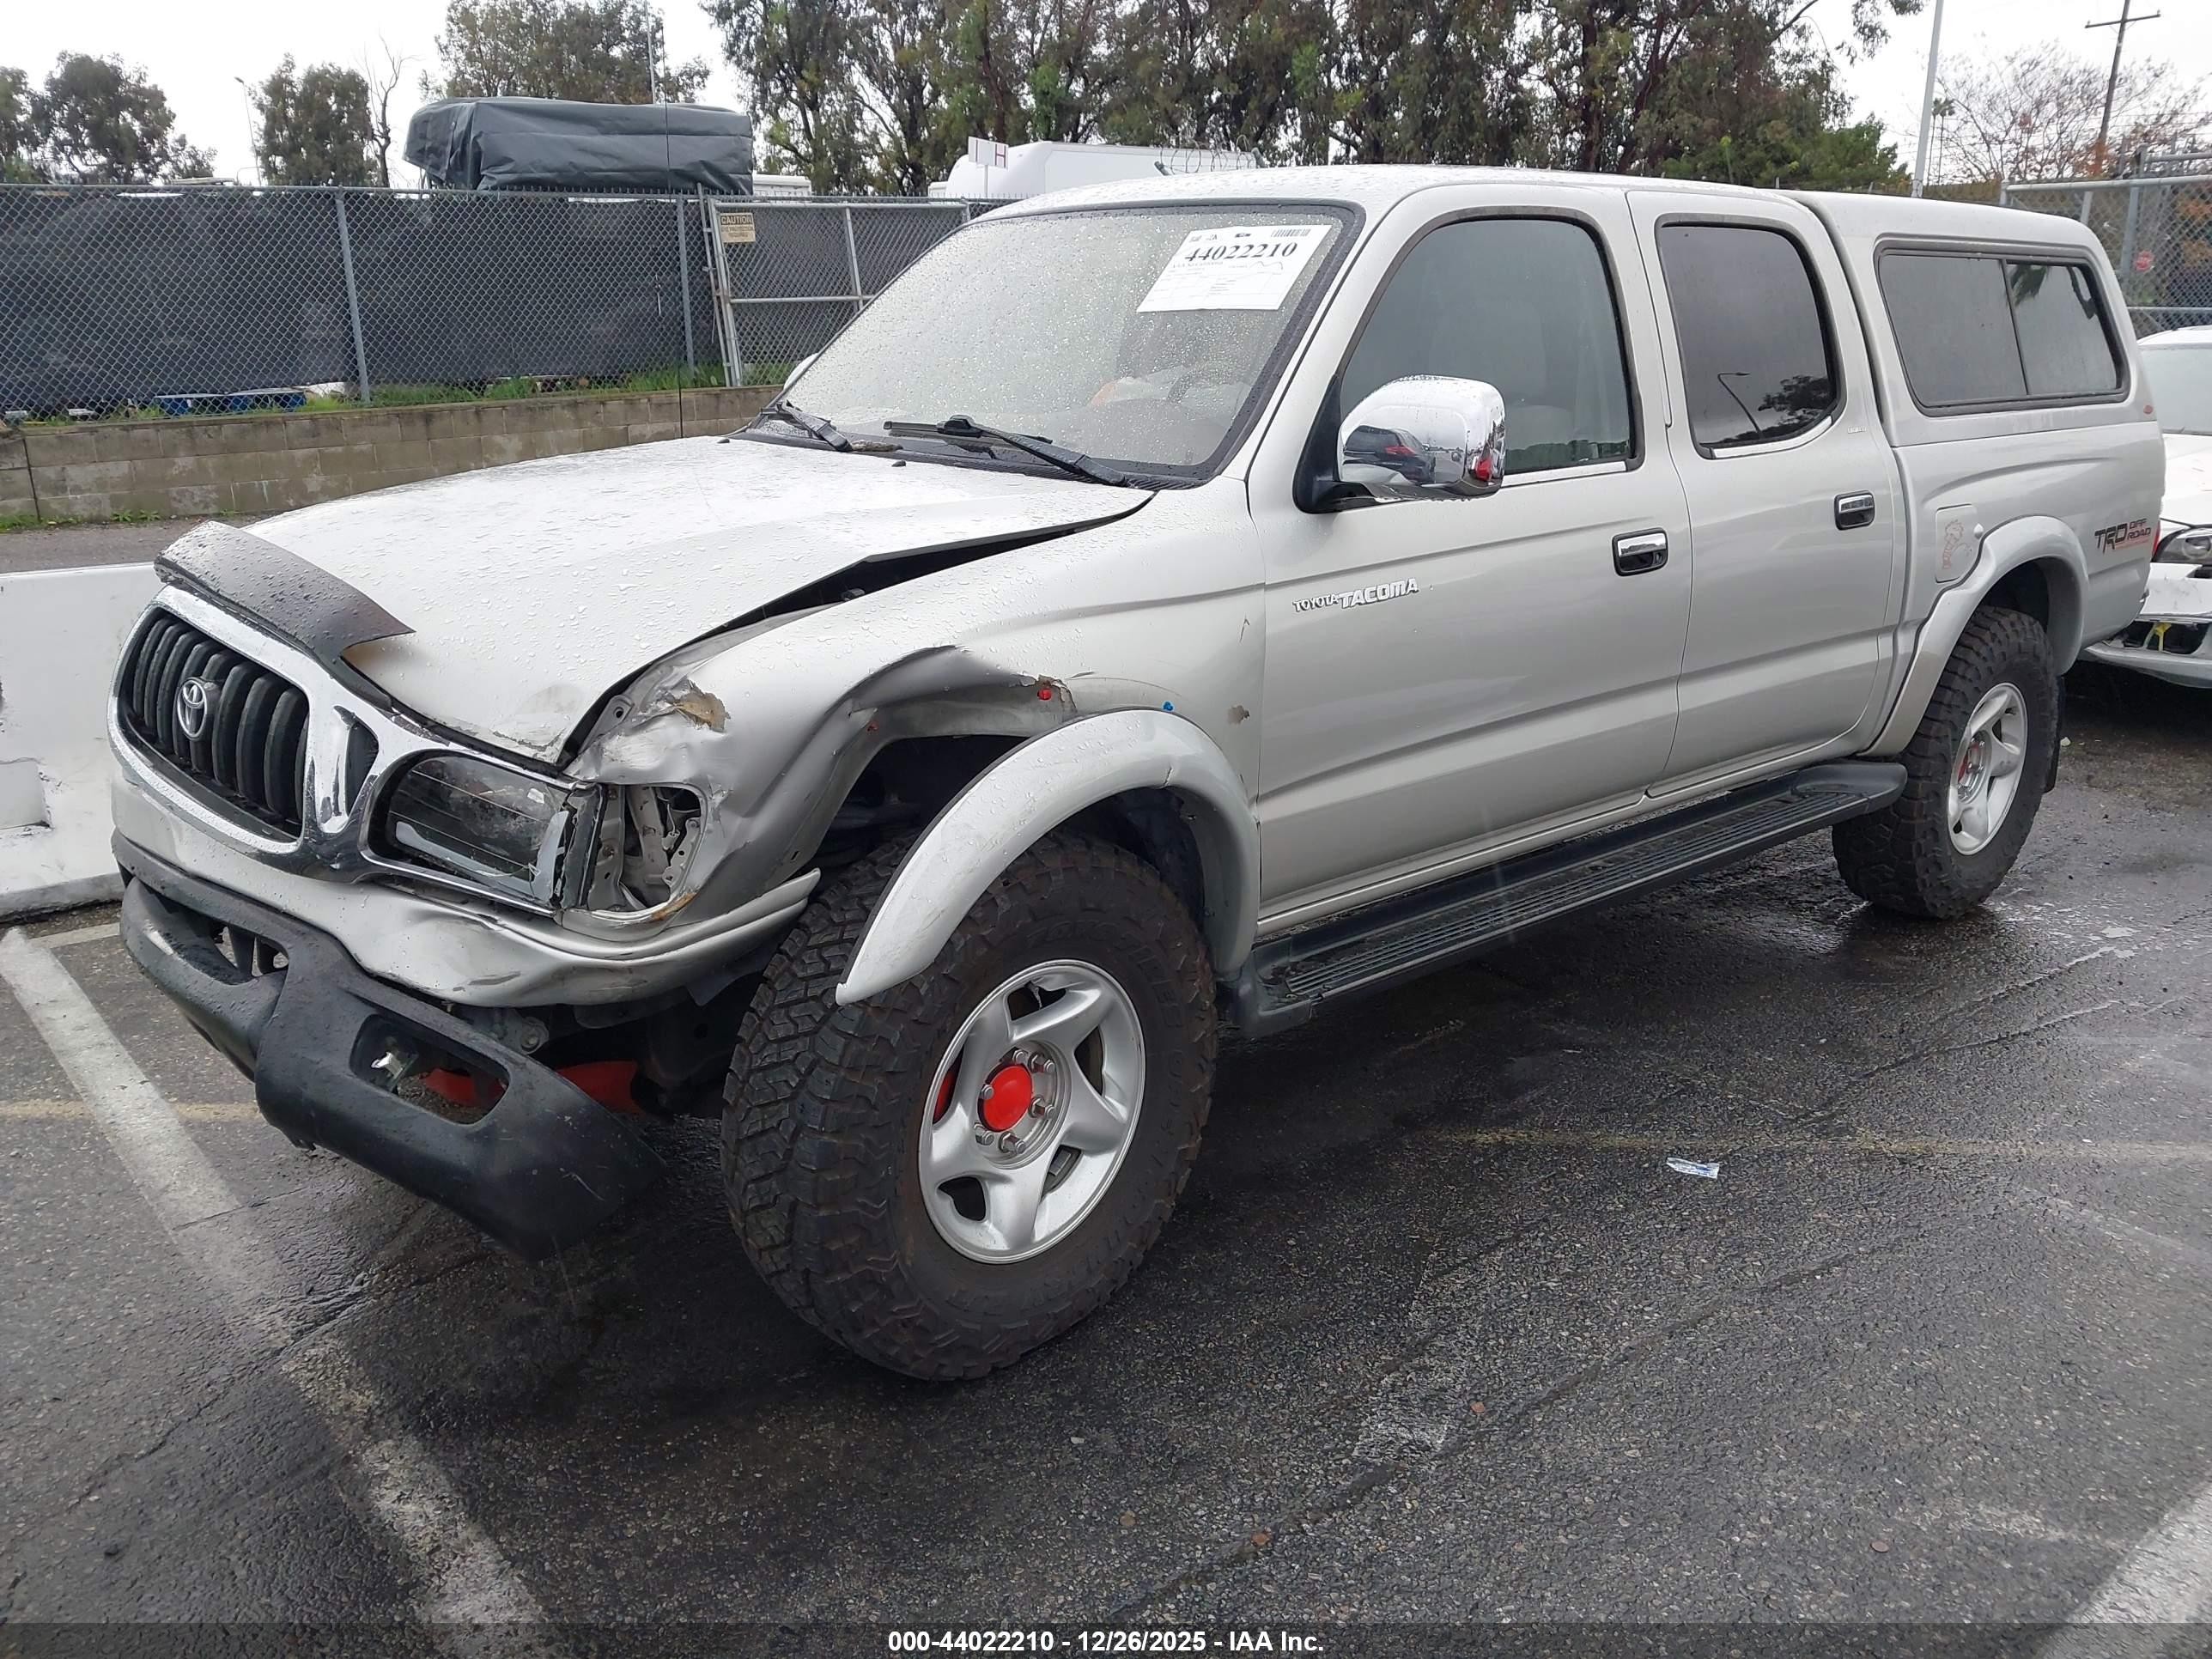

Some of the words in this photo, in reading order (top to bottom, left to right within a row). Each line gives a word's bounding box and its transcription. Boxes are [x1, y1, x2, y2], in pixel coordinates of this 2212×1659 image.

[720, 216, 752, 224] CAUTION
[1184, 242, 1298, 262] 44022210
[2129, 518, 2148, 529] OFF
[2095, 523, 2128, 554] TRD
[2128, 527, 2151, 540] ROAD
[1292, 594, 1340, 612] TOYOTA
[1338, 578, 1419, 609] TACOMA
